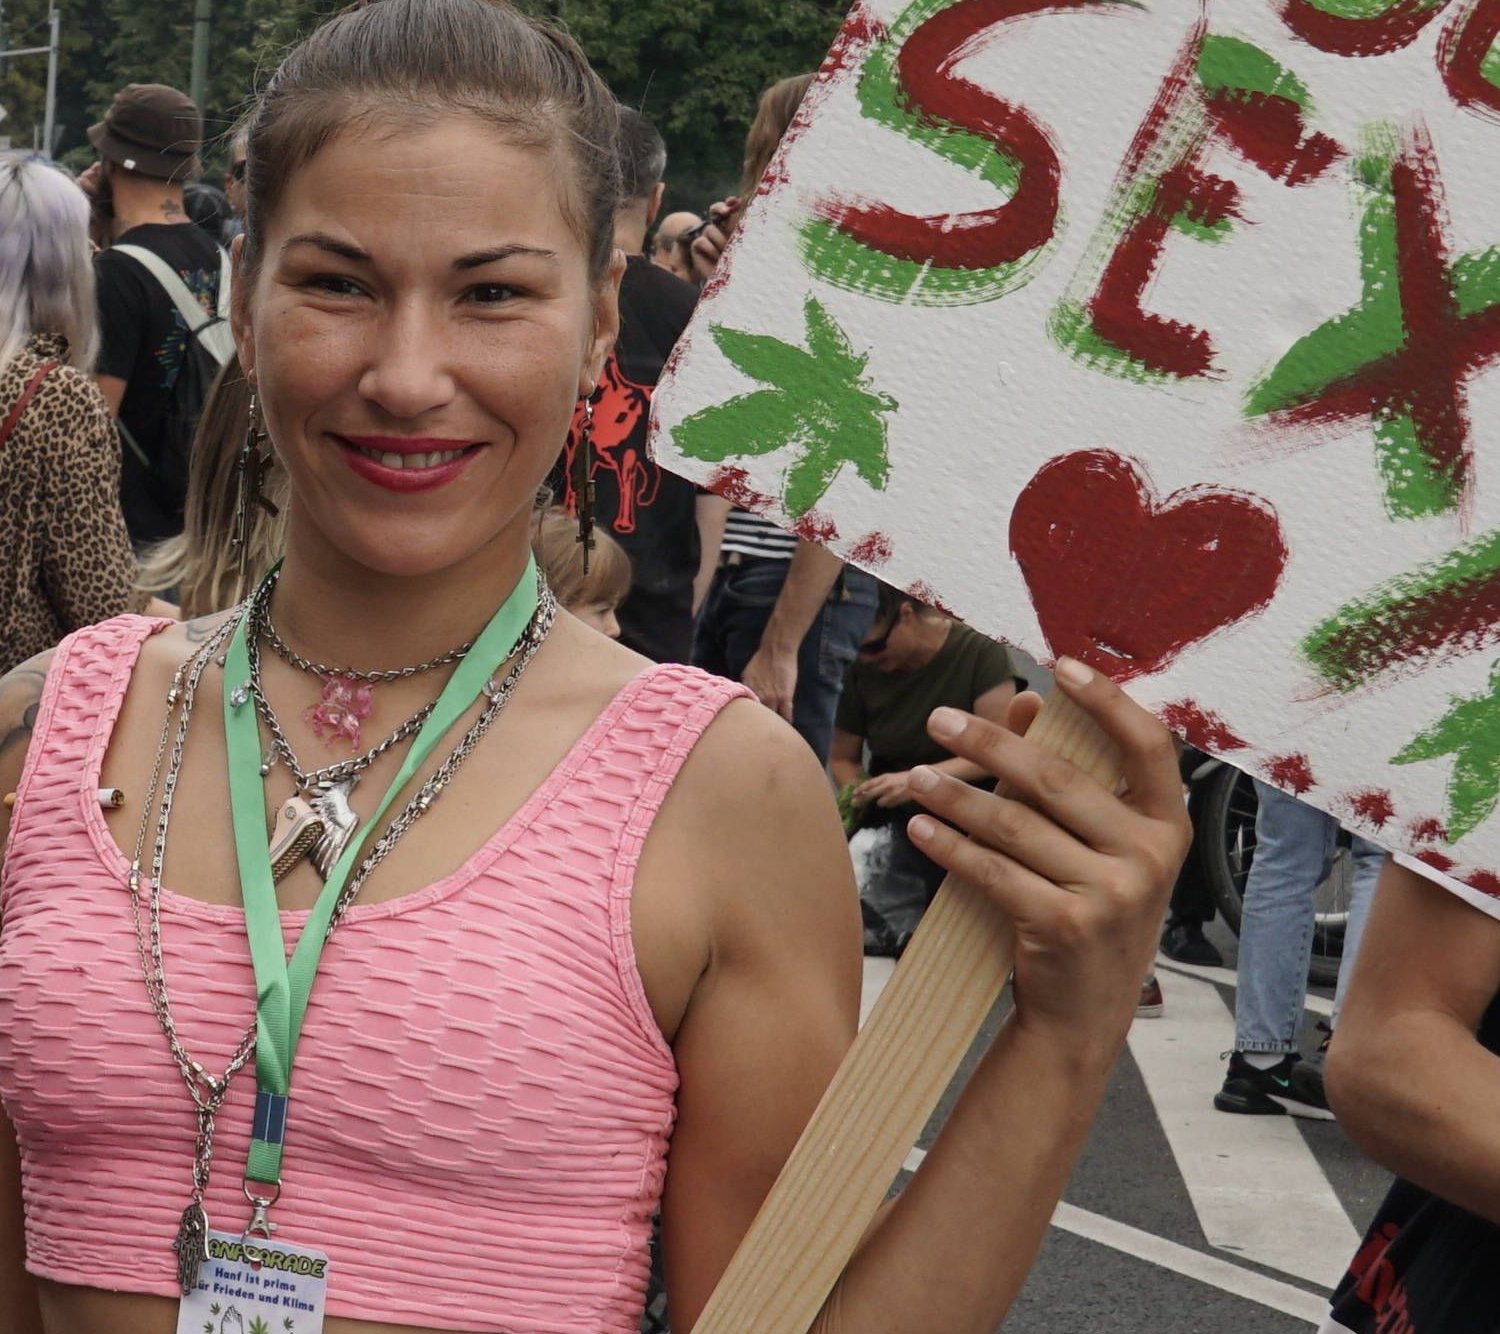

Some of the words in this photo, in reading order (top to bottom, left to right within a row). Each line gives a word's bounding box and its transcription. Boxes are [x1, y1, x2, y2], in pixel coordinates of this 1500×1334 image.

[208, 1238, 328, 1278] ANFPARADE
[215, 1267, 242, 1282] Hanf
[245, 1275, 260, 1285] ist
[263, 1278, 297, 1292] prima
[213, 1283, 255, 1300] Frieden
[258, 1293, 279, 1305] und
[282, 1296, 315, 1312] Klima
